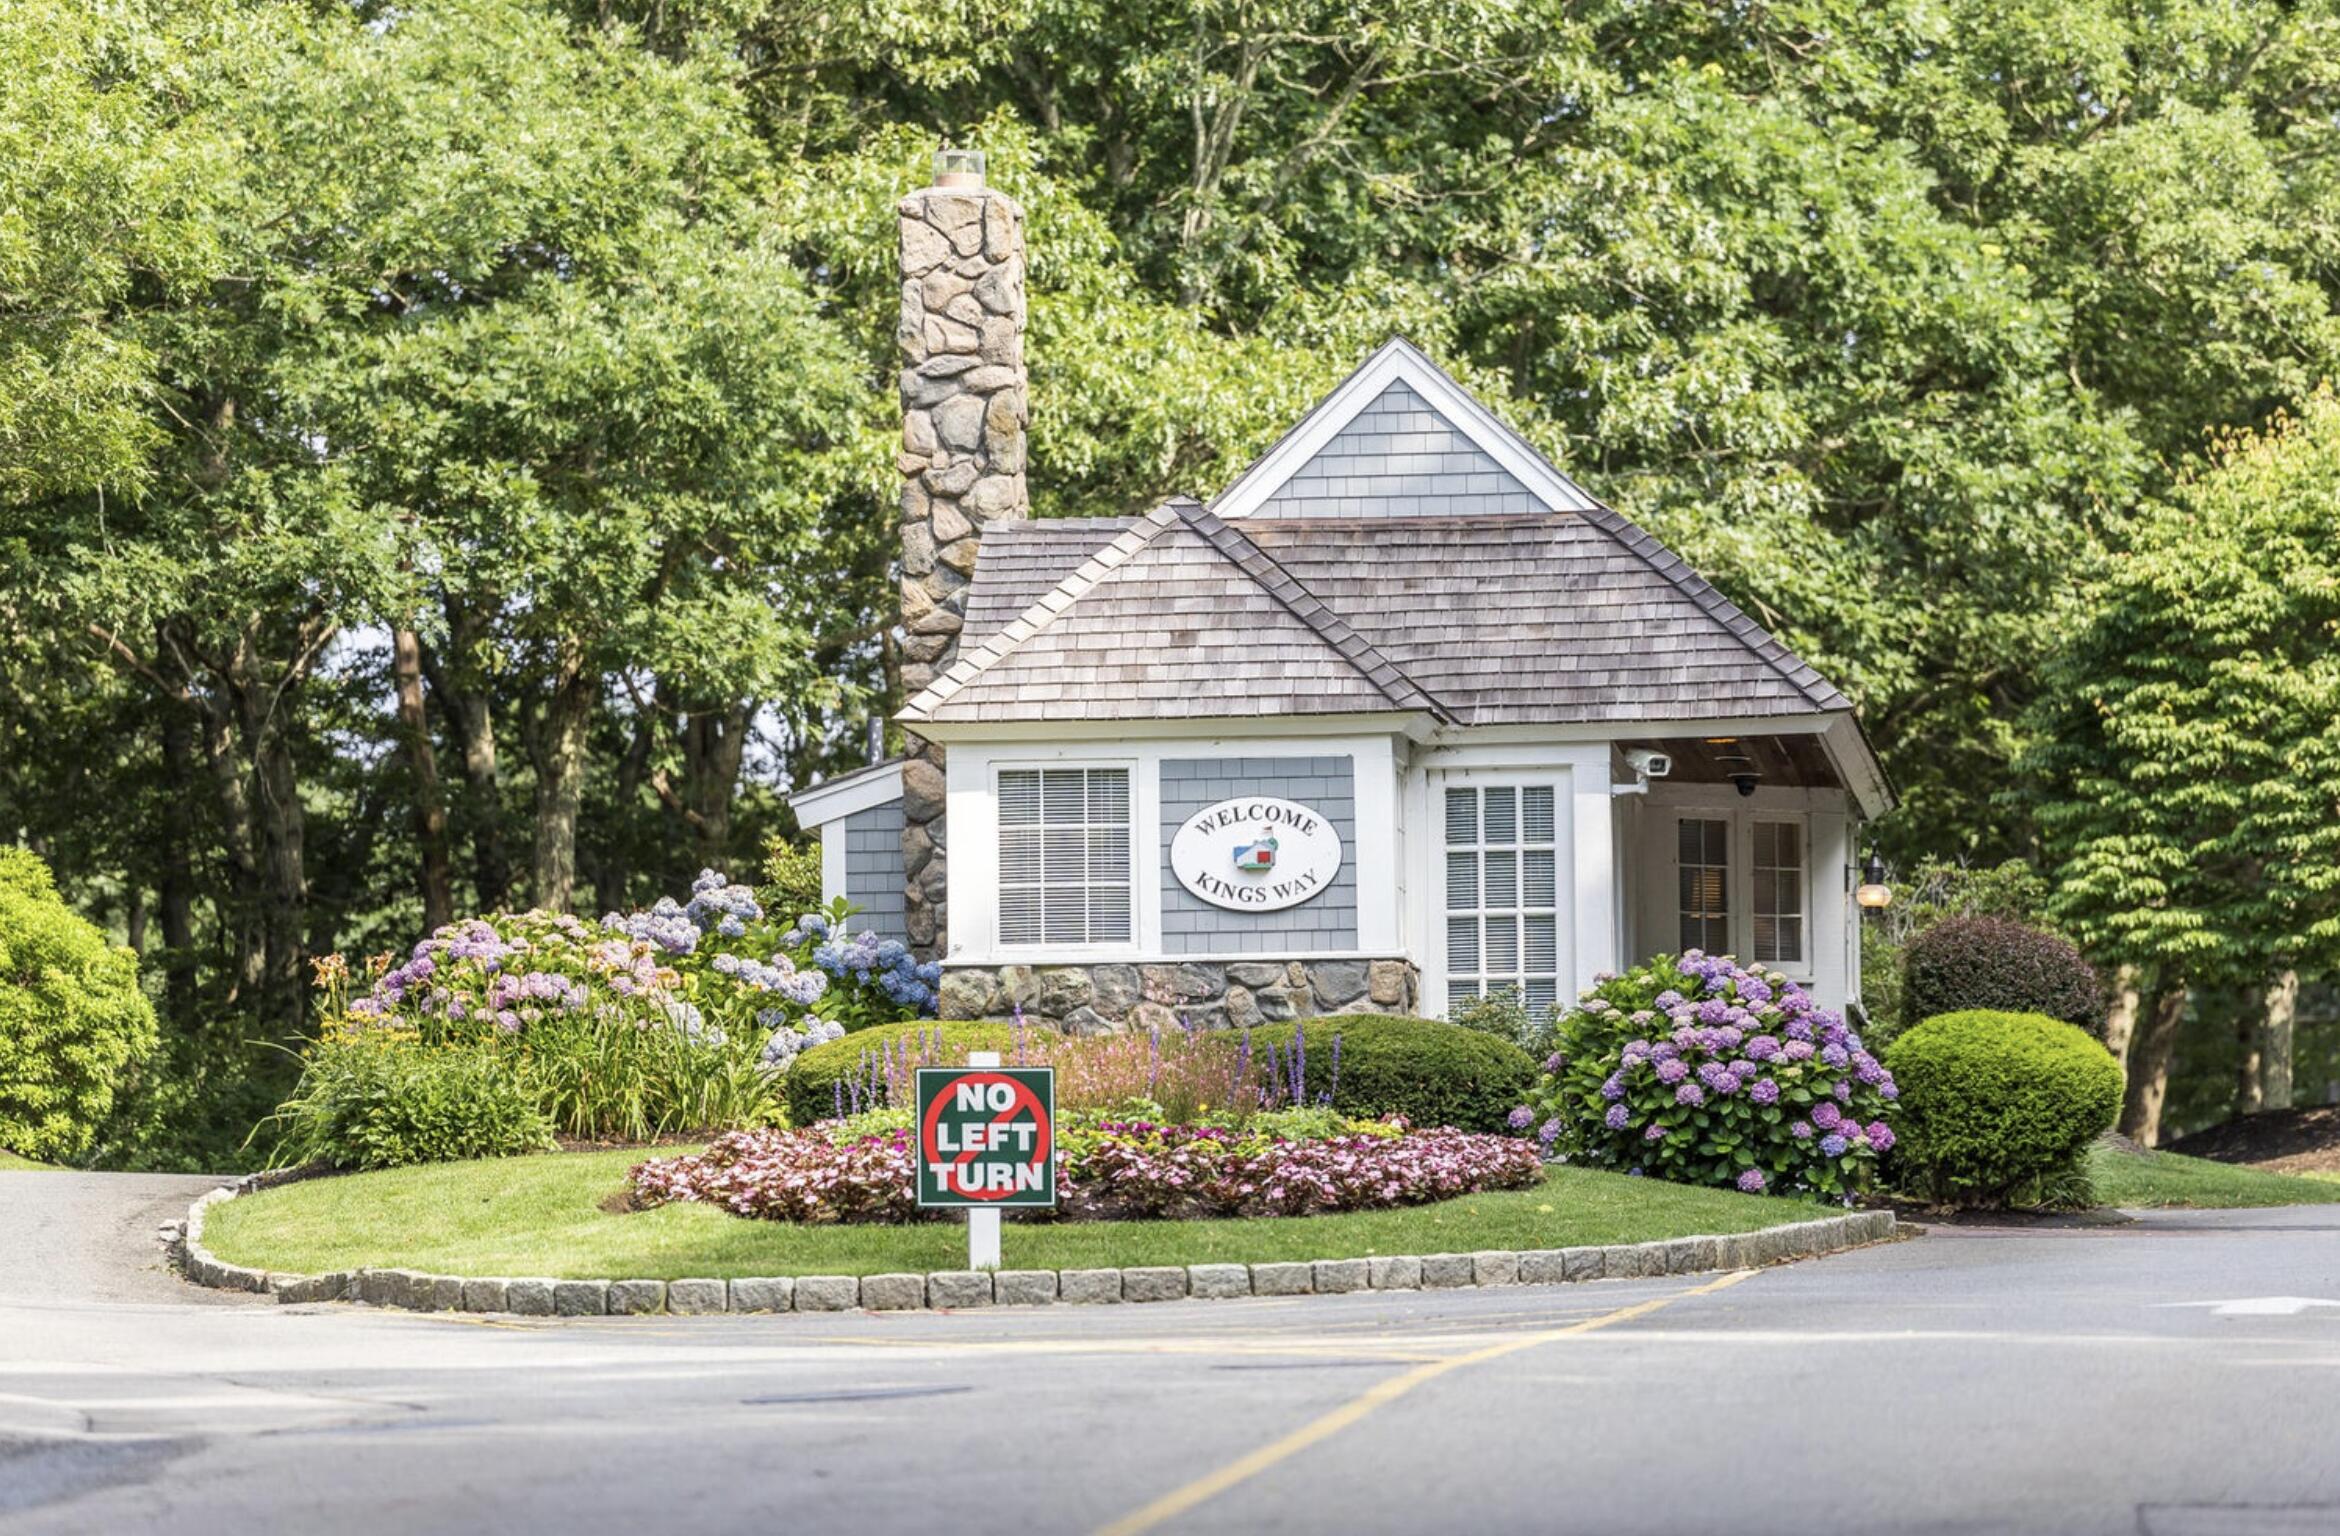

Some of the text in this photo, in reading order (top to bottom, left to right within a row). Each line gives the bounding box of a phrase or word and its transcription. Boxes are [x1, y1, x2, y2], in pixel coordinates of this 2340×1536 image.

[1194, 804, 1318, 837] WELCOME
[1195, 868, 1319, 903] KINGS WAY
[957, 1082, 1016, 1112] NO
[937, 1122, 1037, 1151] LEFT
[929, 1162, 1044, 1192] TURN
